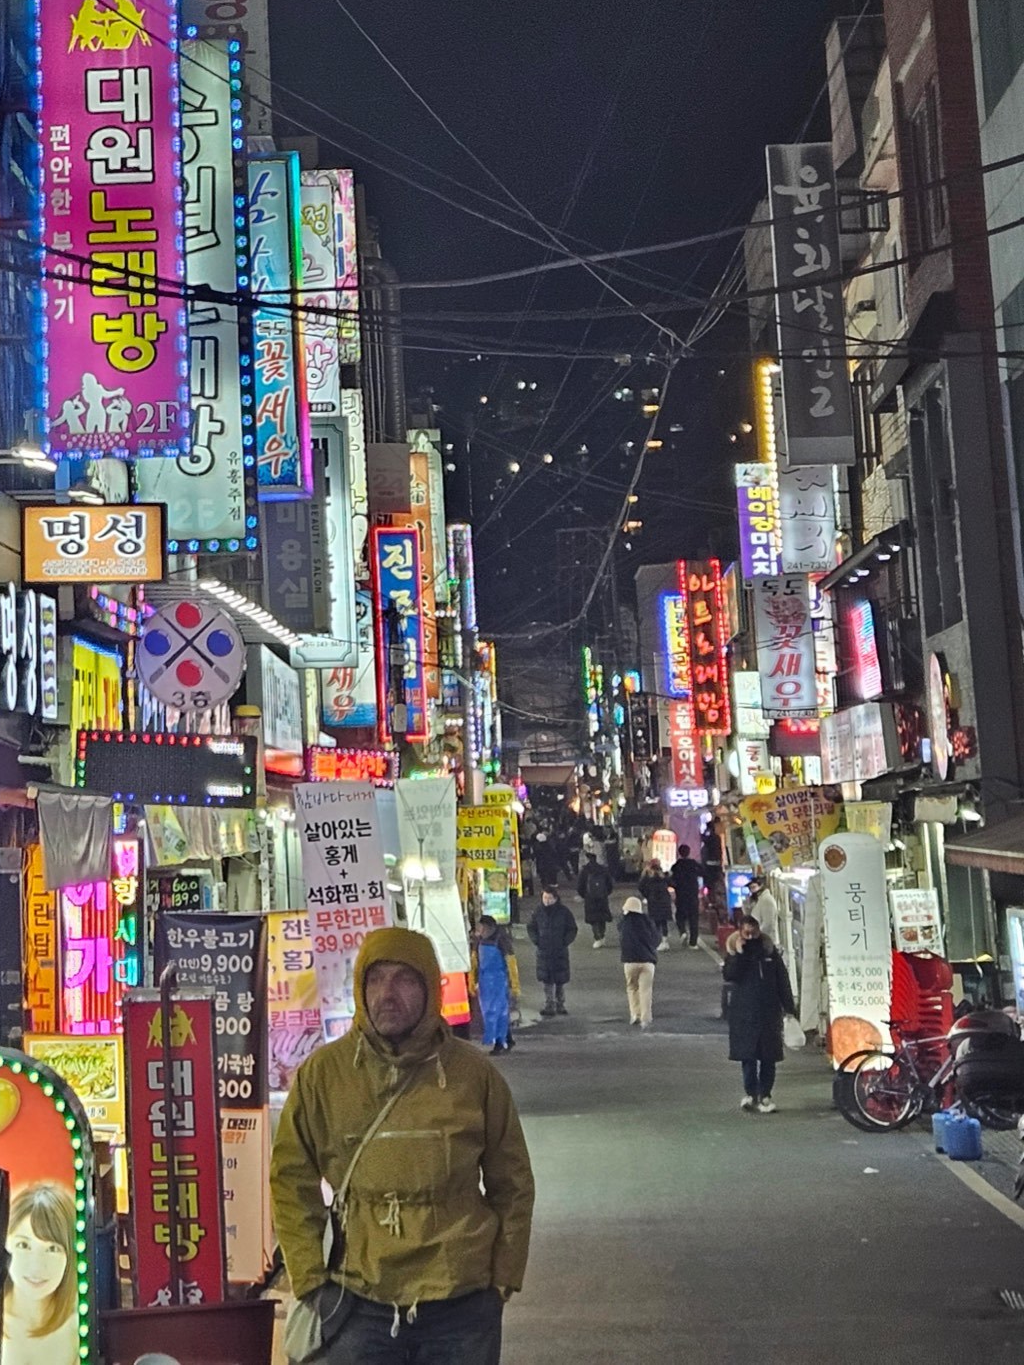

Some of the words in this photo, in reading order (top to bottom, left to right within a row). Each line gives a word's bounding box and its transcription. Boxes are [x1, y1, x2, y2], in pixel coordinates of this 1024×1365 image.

[48, 123, 74, 217] 편안한
[135, 400, 180, 434] 2F
[254, 340, 291, 478] 꽃새우
[39, 511, 146, 557] 명성
[767, 623, 805, 708] 꽃새우
[327, 665, 357, 723] 새우
[303, 818, 374, 843] 살아있는
[323, 844, 360, 867] 홍게
[315, 905, 387, 932] 무한리필
[844, 882, 869, 951] 뭉티기
[166, 927, 255, 950] 한우불고기
[200, 954, 254, 975] 9,900
[850, 966, 883, 978] 35,000
[850, 981, 885, 992] 45,000
